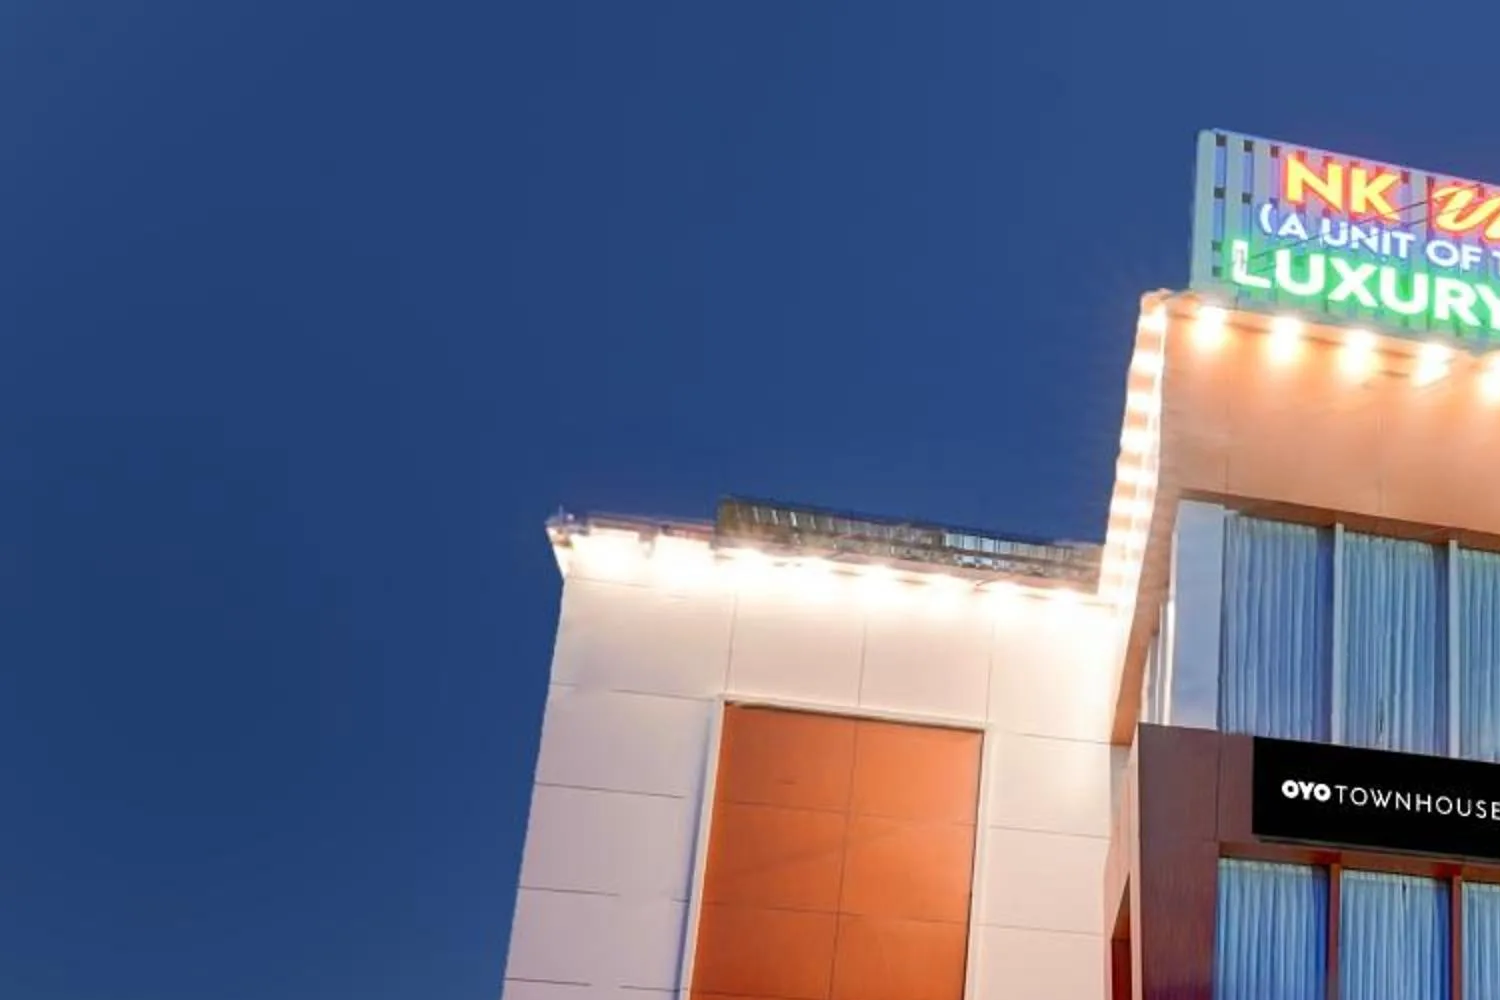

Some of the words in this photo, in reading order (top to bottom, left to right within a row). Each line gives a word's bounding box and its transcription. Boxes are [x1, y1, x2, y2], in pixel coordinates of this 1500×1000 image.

[1286, 153, 1401, 221] NK
[1260, 203, 1308, 240] (A
[1322, 218, 1416, 258] UNIT
[1426, 240, 1483, 271] OF
